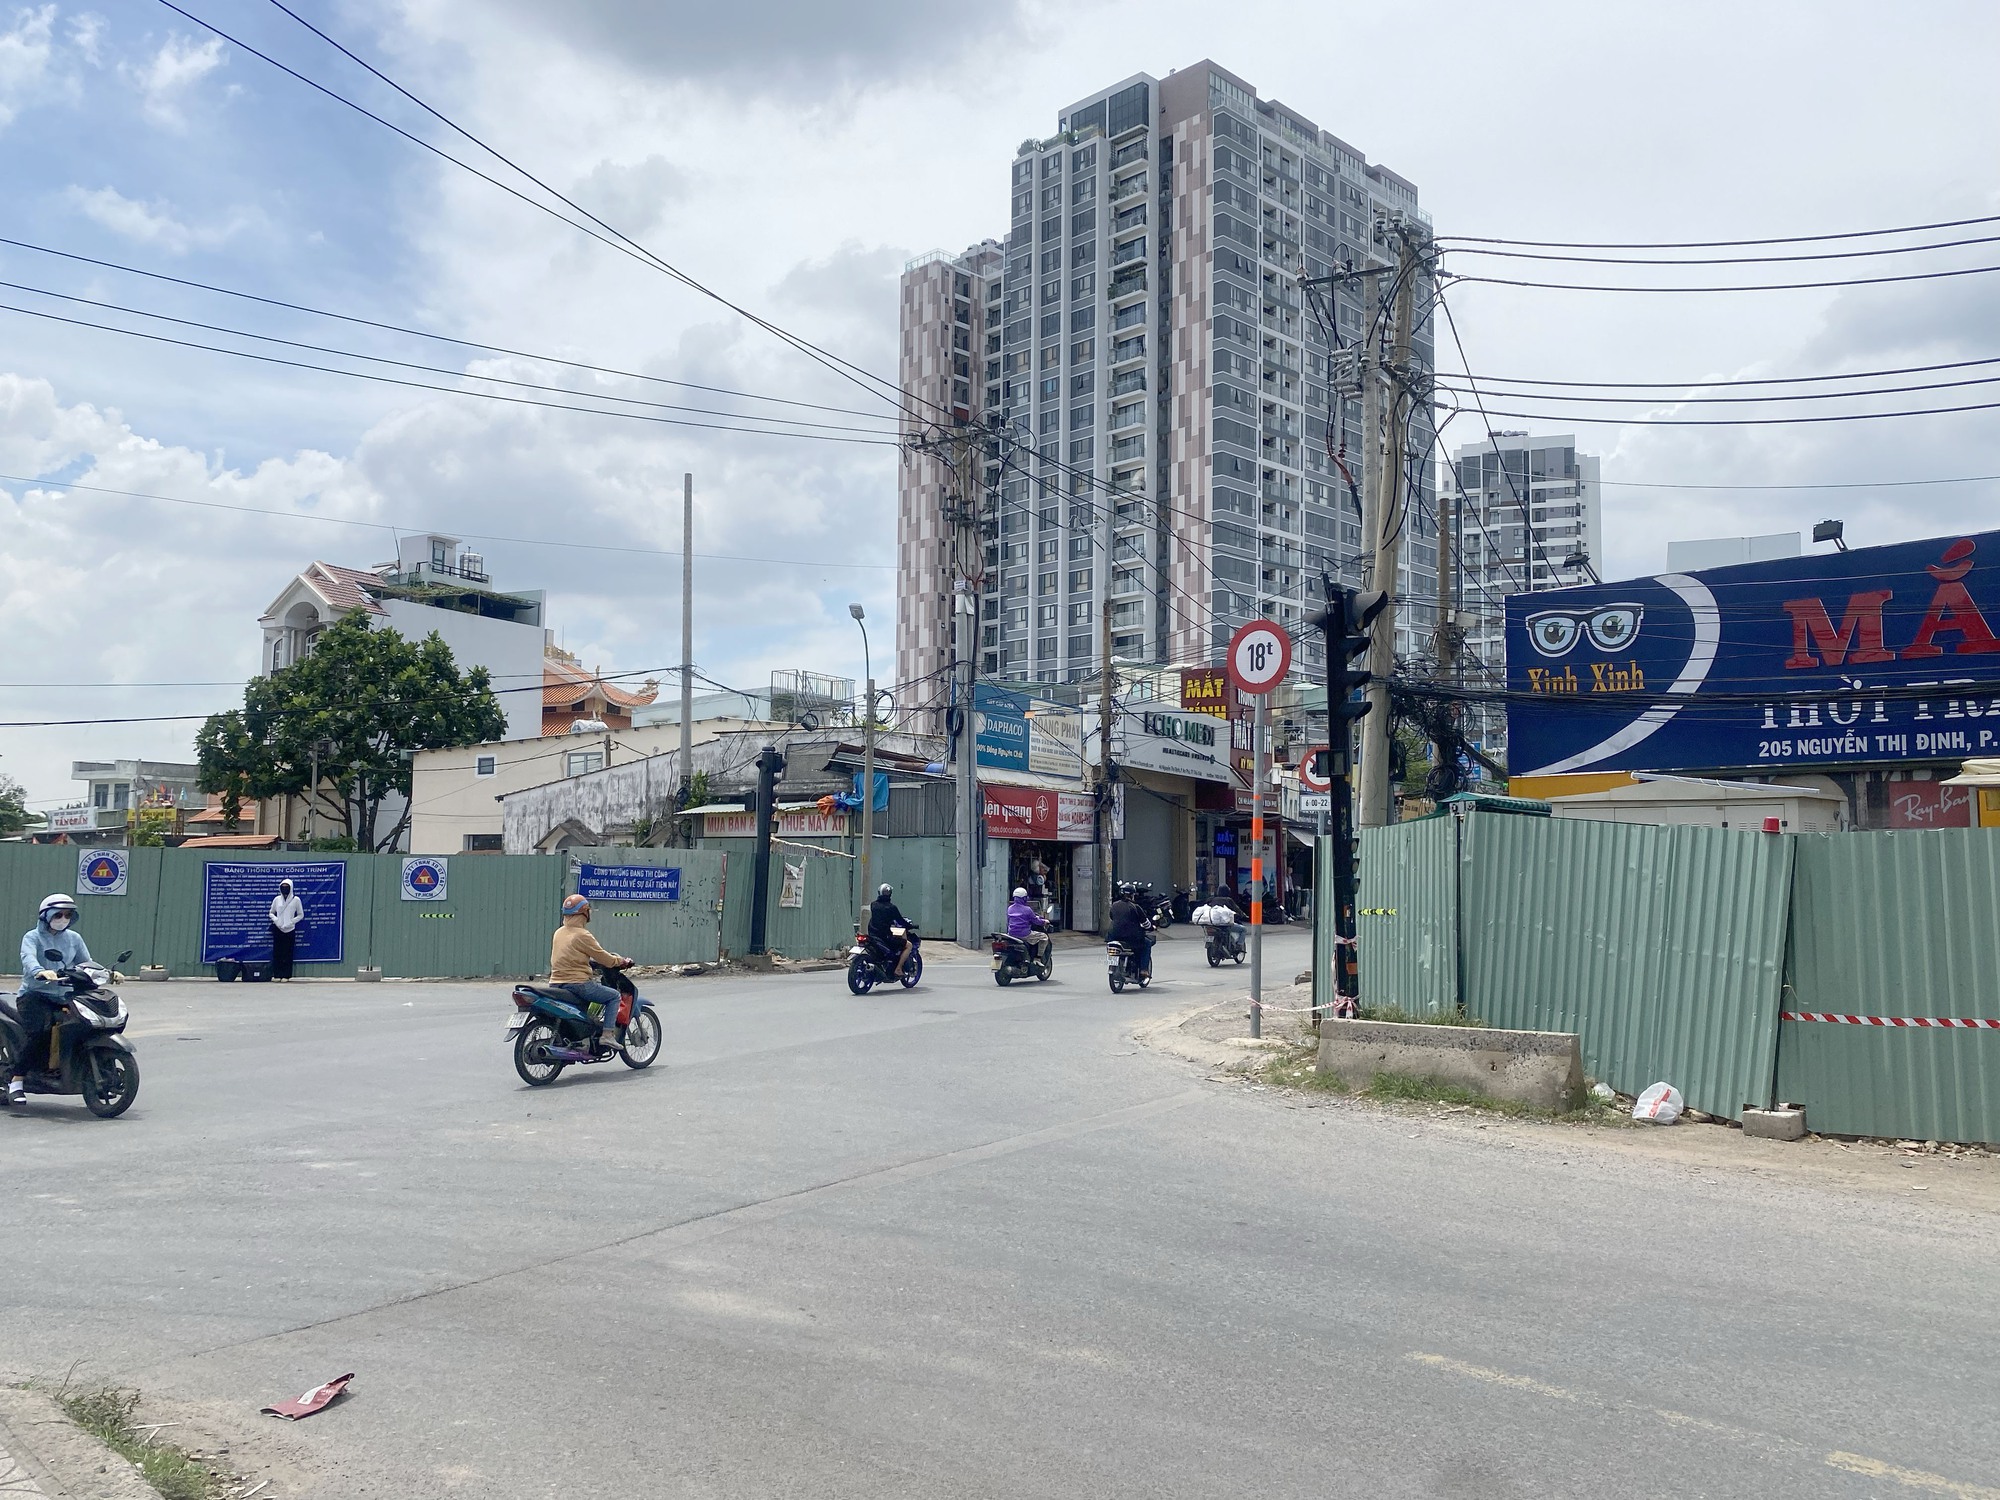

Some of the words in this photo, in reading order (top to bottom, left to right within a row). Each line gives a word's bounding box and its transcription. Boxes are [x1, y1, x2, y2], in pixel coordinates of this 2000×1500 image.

[1186, 671, 1224, 698] MẮT
[1528, 666, 1578, 694] Xinh
[1590, 660, 1645, 692] Xinh
[987, 719, 1022, 736] DAPHACO
[1145, 711, 1182, 738] ECHO
[1185, 720, 1215, 747] MEDI
[977, 744, 986, 752] 00%
[1758, 740, 1792, 757] 205
[1798, 729, 1868, 756] NGUYỄN
[1875, 734, 1907, 756] THỊ
[1916, 732, 1972, 755] ĐỊNH,
[984, 800, 999, 818] iện
[1002, 805, 1032, 824] quang
[707, 816, 725, 832] MUA
[594, 868, 608, 876] CÔNG
[582, 877, 599, 886] CHÚNG
[620, 878, 628, 887] LỖI
[629, 879, 636, 887] VỀ
[637, 880, 644, 889] SỰ
[656, 880, 667, 889] TIỆN
